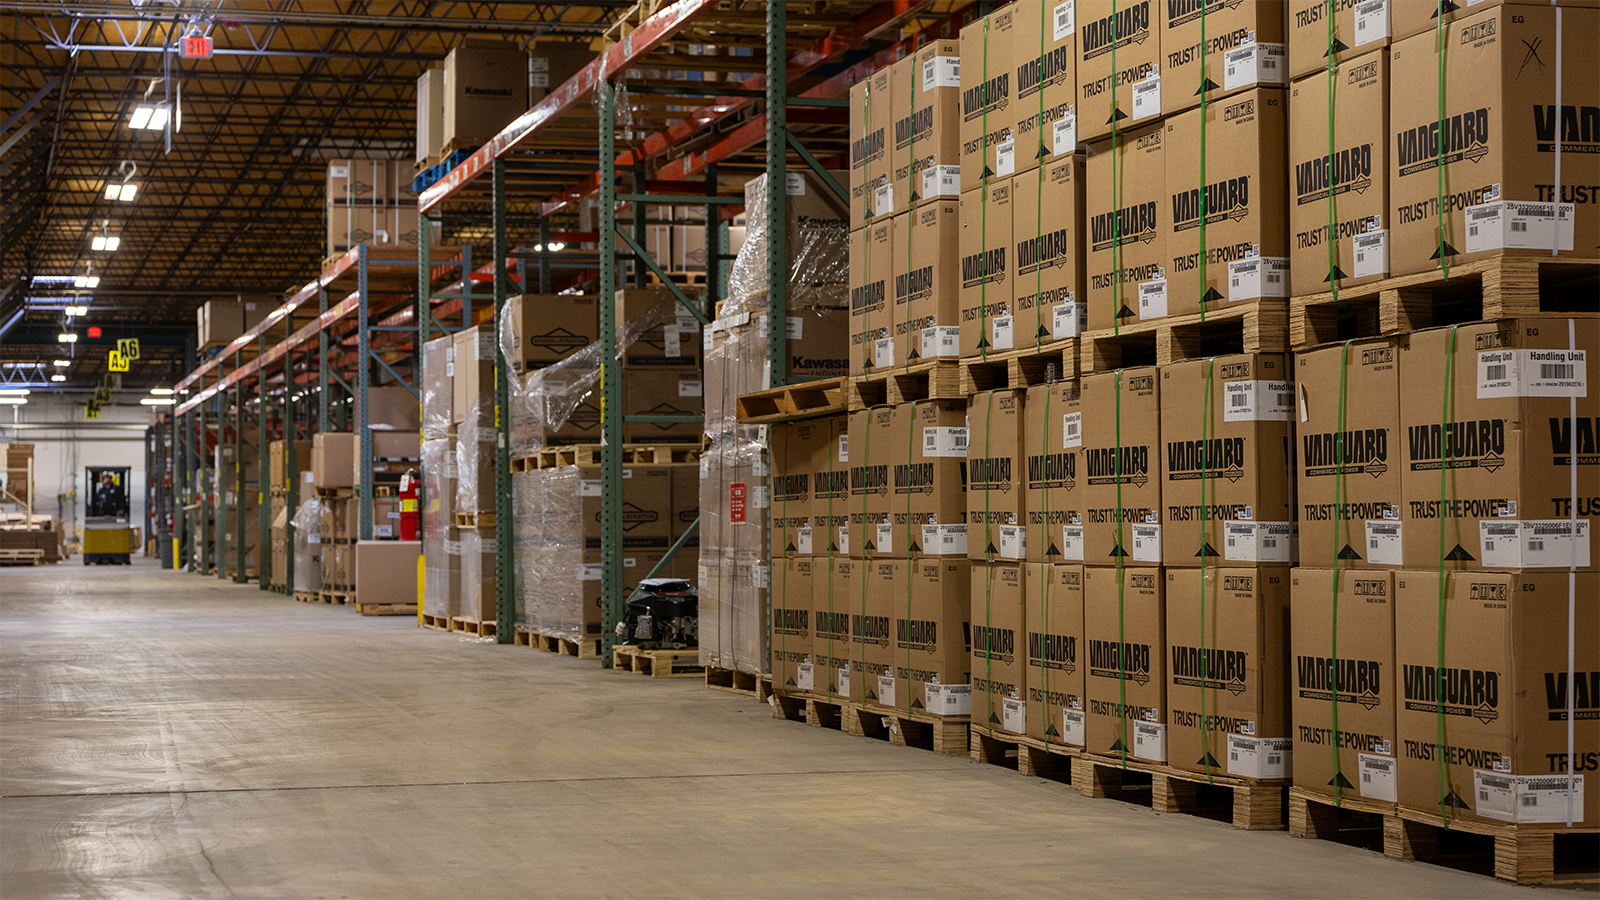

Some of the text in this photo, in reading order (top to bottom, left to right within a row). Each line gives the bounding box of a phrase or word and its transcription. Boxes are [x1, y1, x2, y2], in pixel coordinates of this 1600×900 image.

[1296, 4, 1322, 28] TRUST
[185, 37, 210, 57] EXIT
[1168, 46, 1194, 68] TRUST
[1196, 40, 1212, 58] TE
[466, 86, 512, 96] Kawasaki
[1083, 78, 1106, 98] TRUST
[1107, 72, 1121, 90] TE
[1404, 156, 1458, 174] COMMERCIAL OWER
[1332, 187, 1346, 195] OWER
[1534, 184, 1600, 204] TRUST
[1398, 201, 1428, 224] TRUST
[1450, 187, 1489, 213] POWE
[1506, 203, 1573, 212] 25V3320006F1E0001
[1297, 217, 1370, 249] TRUST TE POWE
[1174, 253, 1199, 272] TRUST
[1092, 272, 1114, 290] TRUST
[120, 340, 137, 358] A6
[1530, 352, 1584, 362] Handling Unit
[1268, 383, 1296, 392] Handlin
[1408, 419, 1504, 460] VANGUARD
[1549, 418, 1600, 454] VA
[1088, 508, 1108, 523] TRUST
[1169, 506, 1194, 521] TRUST
[1212, 504, 1245, 520] POWE
[1305, 504, 1332, 520] TRUST
[1410, 499, 1505, 518] TRUST THE POWE
[1178, 678, 1202, 687] COMMERCIA
[1404, 664, 1498, 708] VANGUARD
[1090, 700, 1110, 716] TRUST
[1124, 705, 1151, 721] POWE
[1410, 704, 1444, 713] COMMERCIL
[1173, 710, 1197, 728] TRUST
[1299, 726, 1325, 745] TRUST
[1404, 740, 1435, 761] TRUST
[1546, 752, 1600, 772] TRUS
